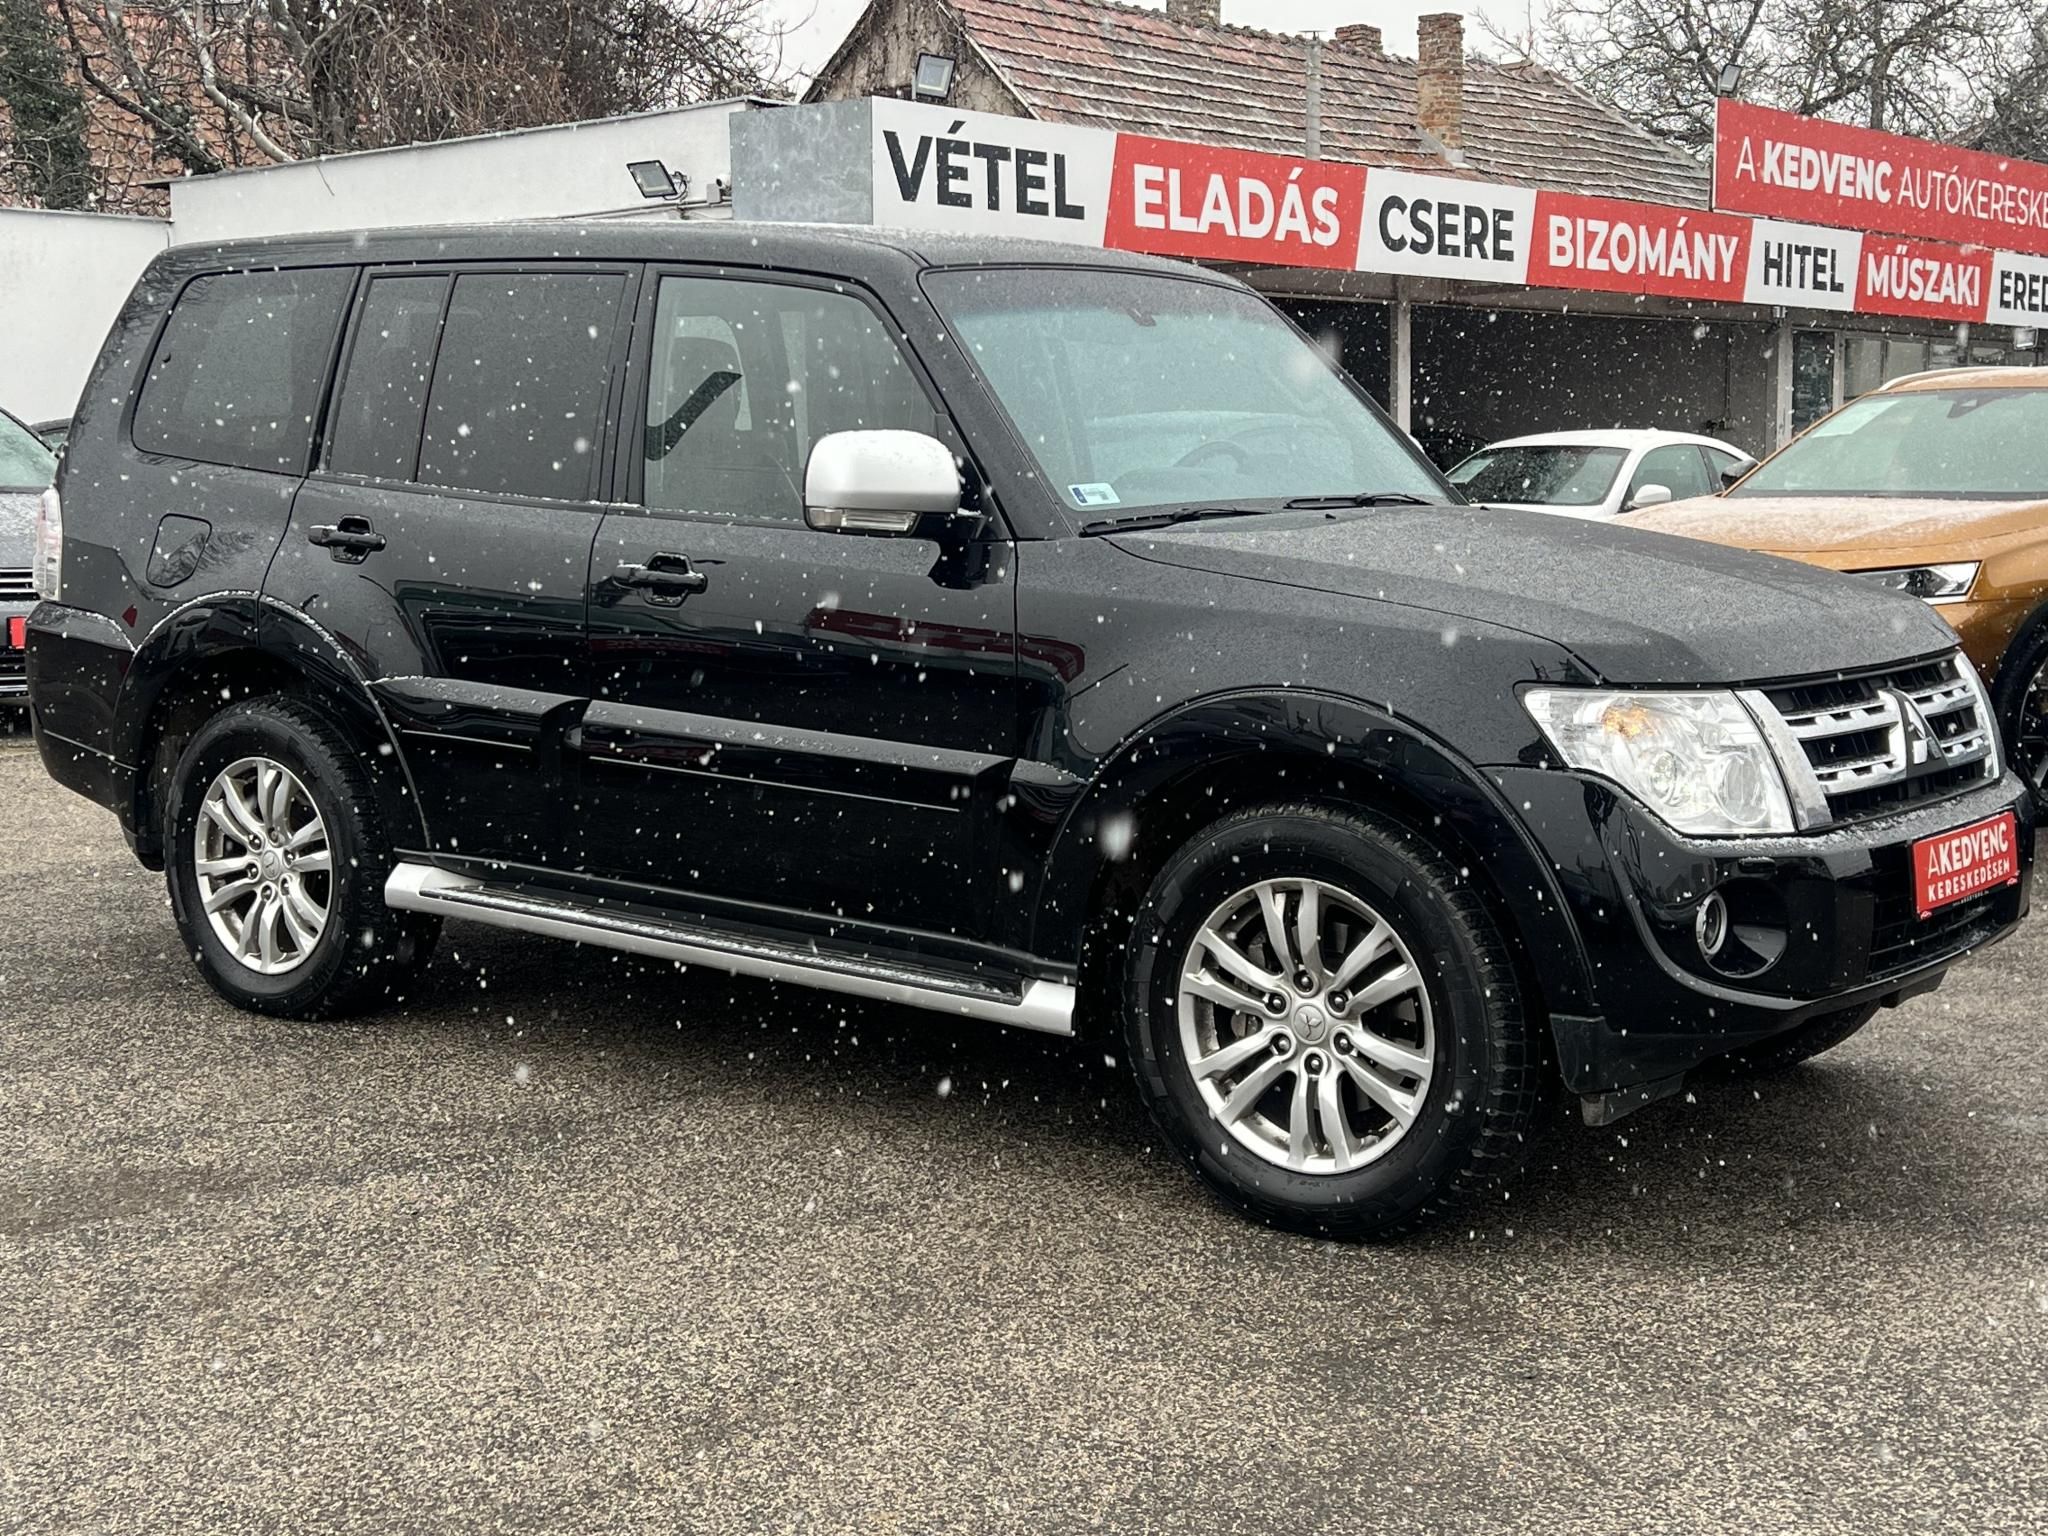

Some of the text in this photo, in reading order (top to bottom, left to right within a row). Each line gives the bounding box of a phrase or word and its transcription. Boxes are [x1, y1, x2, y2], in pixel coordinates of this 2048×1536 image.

[1735, 135, 1756, 181] A
[1763, 139, 1892, 201] KEDVENC
[882, 120, 1086, 220] VÉTEL
[1133, 163, 1341, 247] ELADÁS
[1379, 195, 1514, 262] CSERE
[1548, 215, 1739, 283] BIZOMÁNY
[1763, 240, 1845, 293] HITEL
[1866, 245, 1981, 307] MŰSZAKI
[1927, 857, 2011, 903] KERESKEDÉSEM
